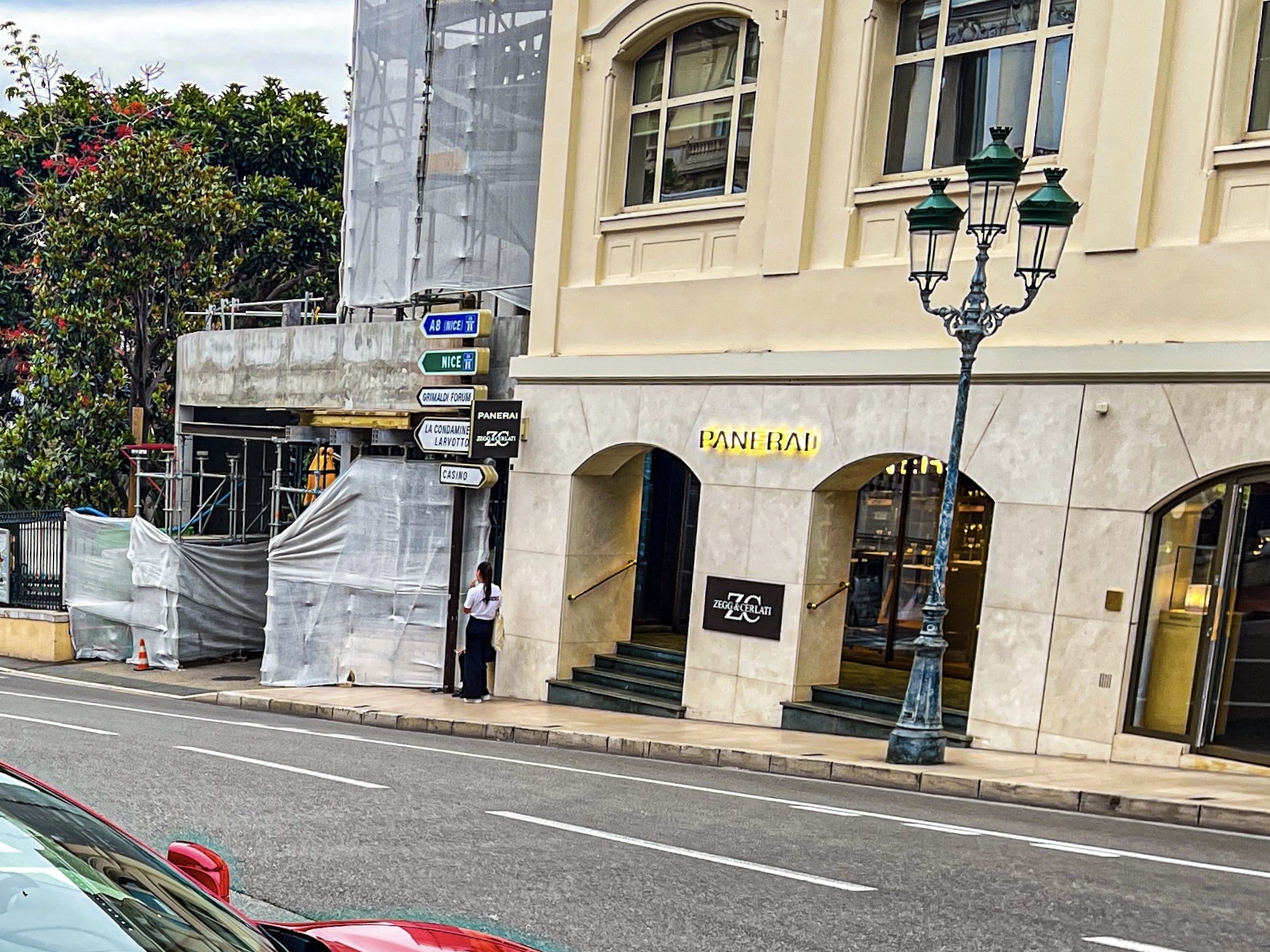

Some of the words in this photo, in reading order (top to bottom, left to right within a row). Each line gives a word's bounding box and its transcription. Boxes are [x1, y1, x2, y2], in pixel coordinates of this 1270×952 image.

[429, 320, 441, 331] A8
[441, 356, 462, 369] NICE
[422, 392, 449, 402] GRIMALDI
[451, 392, 471, 402] FORUM
[477, 411, 519, 420] PANERAI
[425, 424, 433, 434] LA
[434, 425, 470, 435] CONDAMINE
[434, 437, 469, 447] LARVOTTO
[442, 470, 468, 481] CASINO
